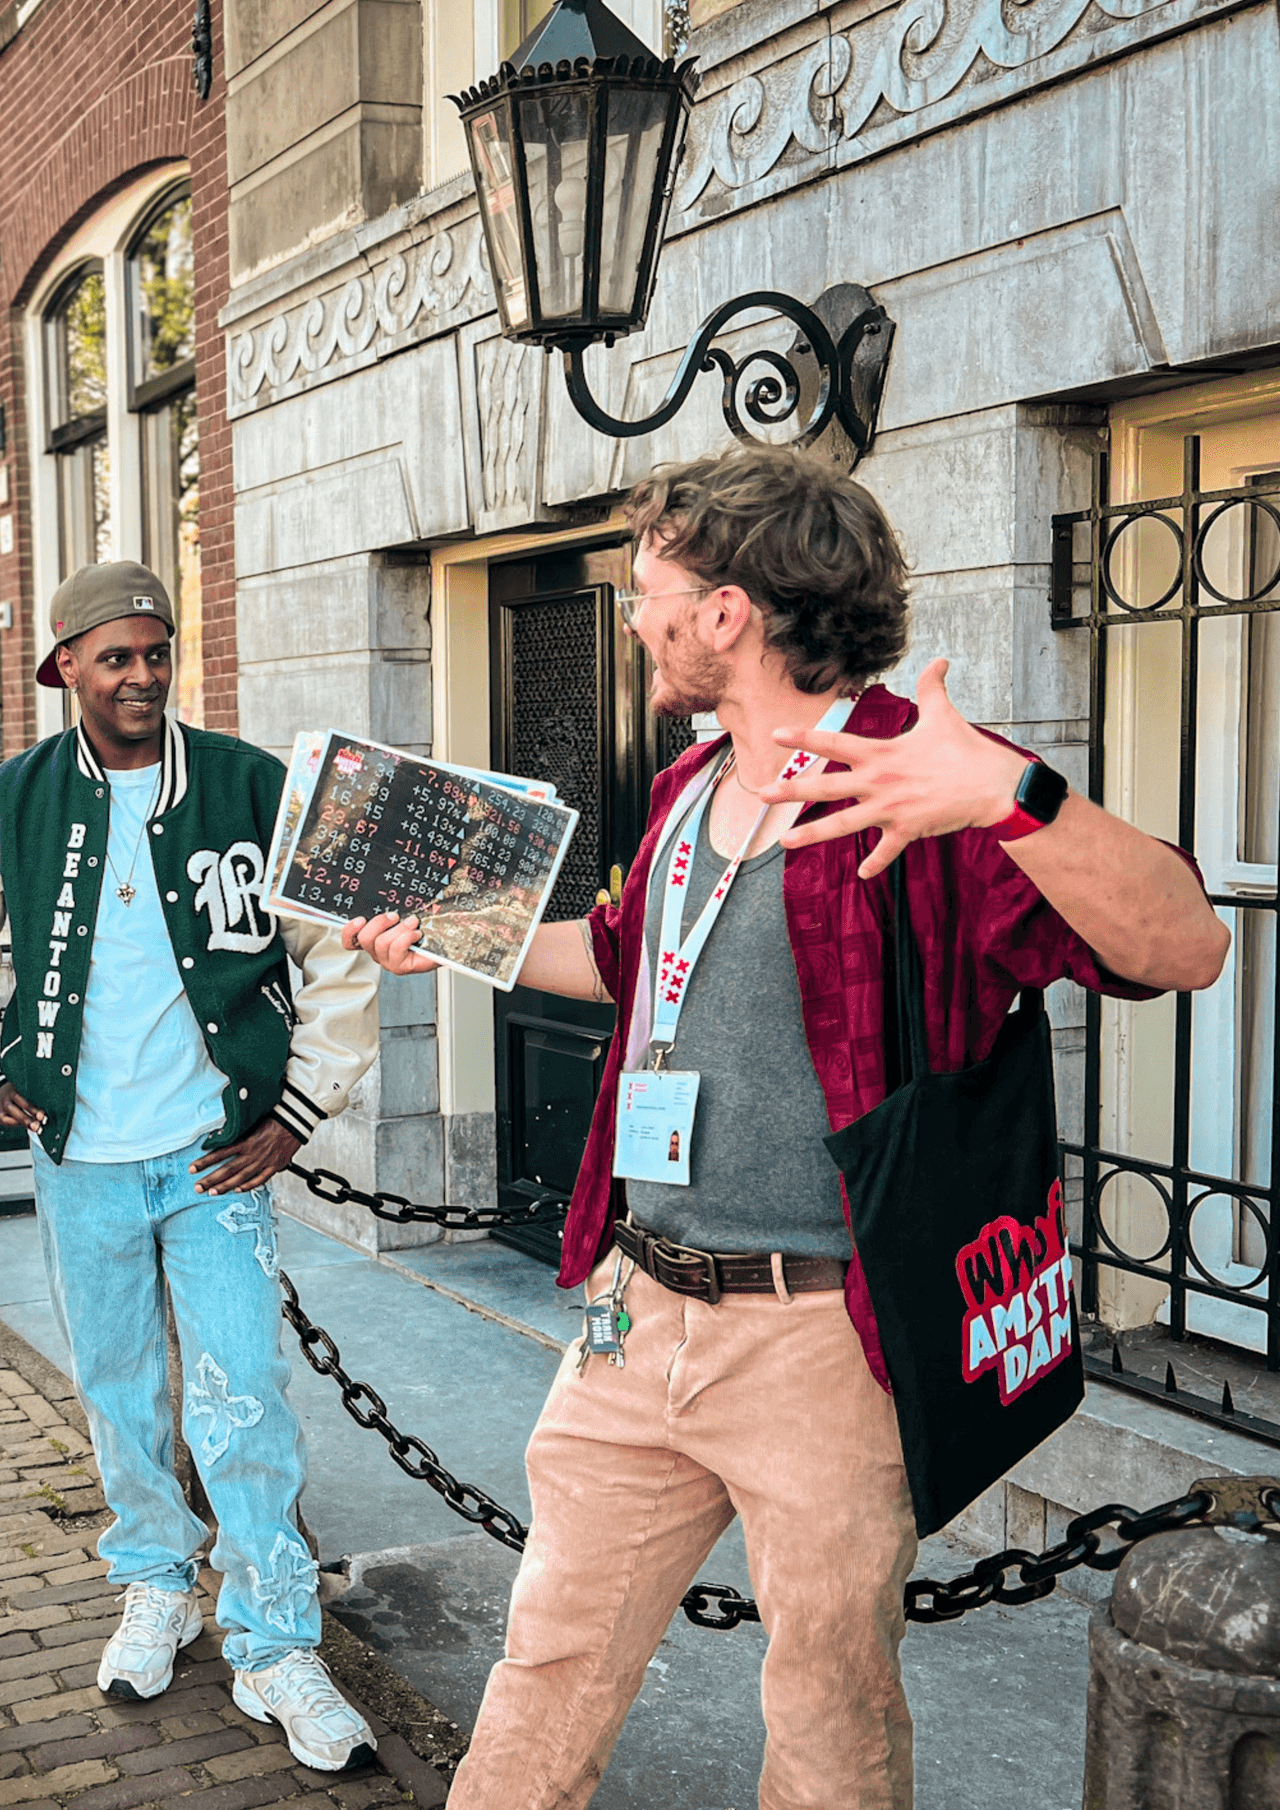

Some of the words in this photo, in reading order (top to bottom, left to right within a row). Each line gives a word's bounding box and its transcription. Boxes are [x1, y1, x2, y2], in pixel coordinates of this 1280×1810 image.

[330, 785, 384, 820] 16.45
[400, 820, 451, 851] +6.43%
[406, 802, 457, 835] +2.13%
[412, 784, 462, 820] +5.97%
[315, 825, 371, 856] 34.64
[389, 854, 440, 882] +23.1%
[321, 804, 378, 838] 23.67
[395, 839, 446, 867] -11.6%
[297, 883, 354, 909] 13.44
[303, 864, 360, 892] 12.78
[310, 844, 366, 874] 43.69
[383, 871, 436, 898] +5.56%
[36, 823, 86, 1059] BEANTOWN
